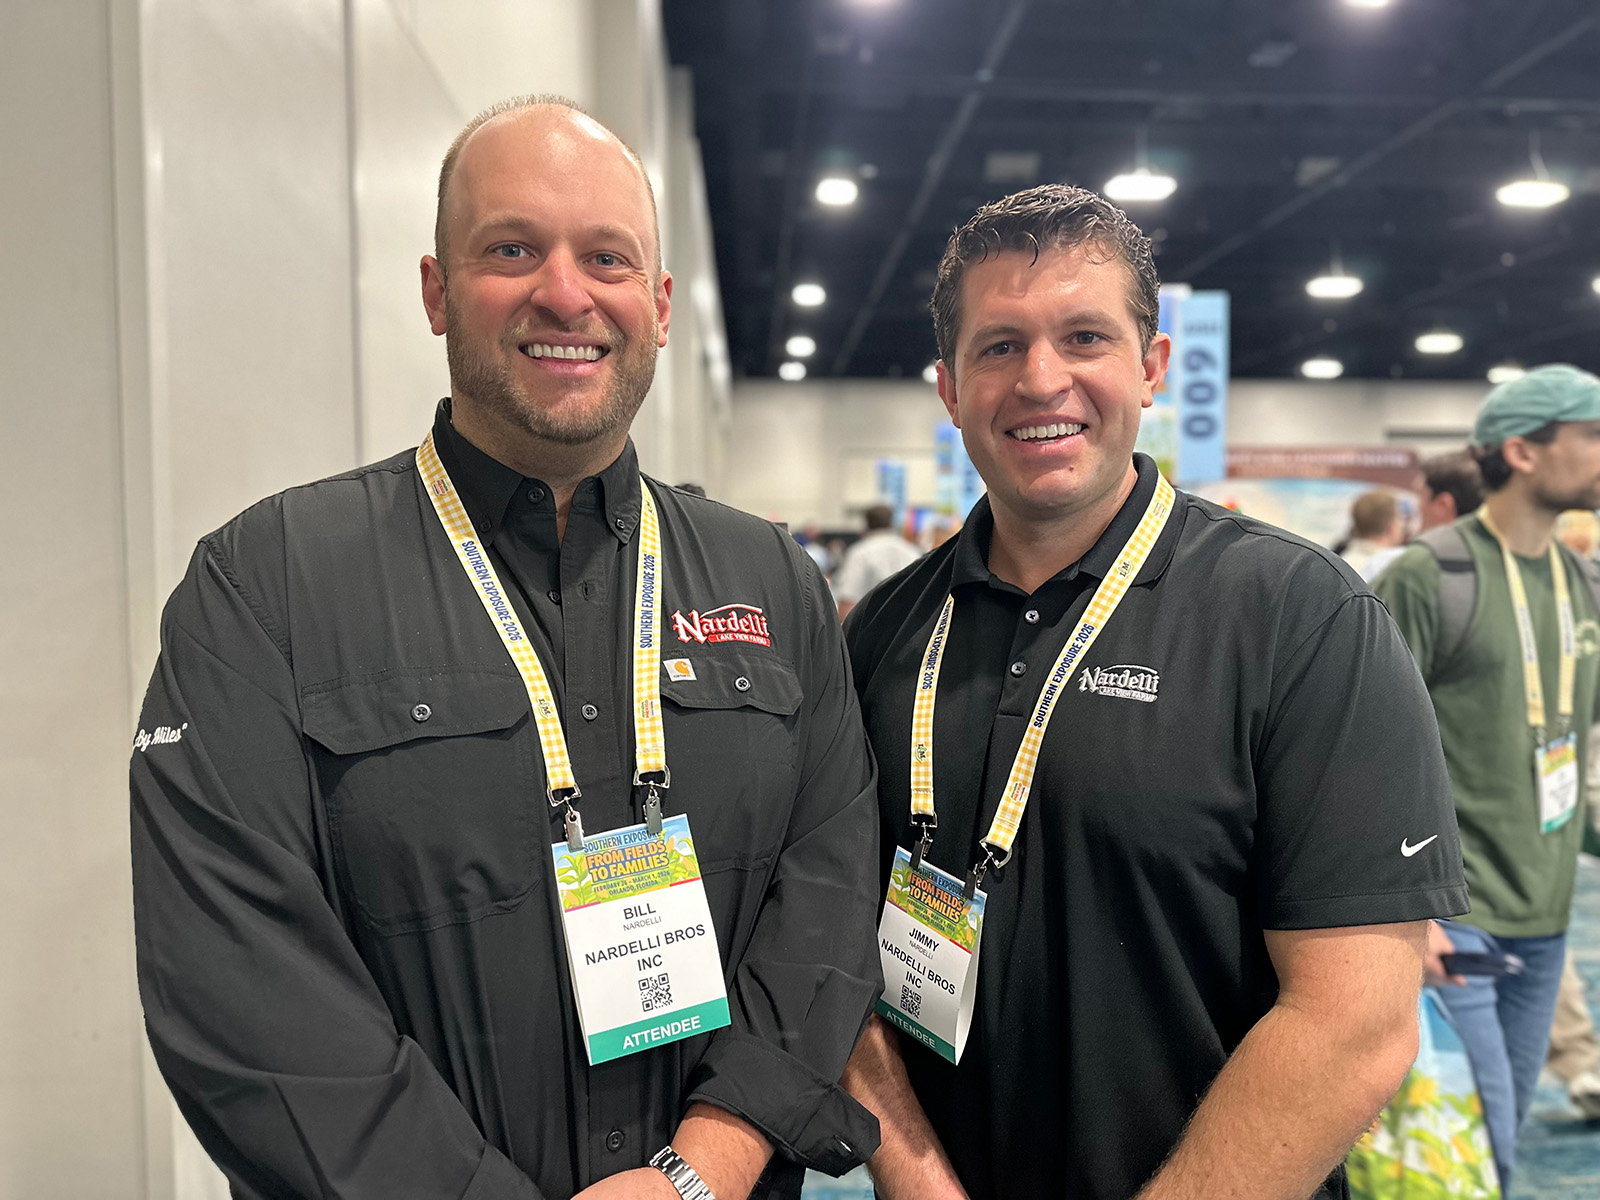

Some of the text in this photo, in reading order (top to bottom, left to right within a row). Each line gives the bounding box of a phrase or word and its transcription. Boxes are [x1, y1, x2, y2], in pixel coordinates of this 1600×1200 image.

[1183, 347, 1218, 441] 600
[462, 540, 523, 641] SOUTHERN EXPOSURE 2026
[640, 553, 655, 649] SOUTHERN EXPOSURE 2026
[671, 609, 770, 645] Nardelli
[715, 632, 734, 641] LAKE
[926, 635, 943, 671] EXPOSURE
[922, 671, 934, 690] 2026
[1033, 623, 1095, 728] SOUTHERN EXPOSURE 2026
[1078, 666, 1160, 693] Nardelli
[584, 832, 623, 853] SOUTHERN
[587, 840, 666, 868] FROM FIELDS
[589, 853, 670, 882] TO FAMILIES
[910, 884, 961, 924] TO FAMILIES
[911, 874, 964, 911] FROM FIELDS
[623, 903, 656, 920] BILL
[623, 916, 662, 931] NARDELLI
[585, 924, 706, 965] NARDELLI BROS
[909, 928, 940, 952] JIMMY
[909, 940, 934, 960] NARDELLI
[637, 954, 663, 971] INC
[881, 938, 956, 995] NARDELLI BROS
[905, 971, 922, 989] INC
[622, 1015, 701, 1050] ATTENDEE
[886, 1010, 936, 1049] ATTENDEE
